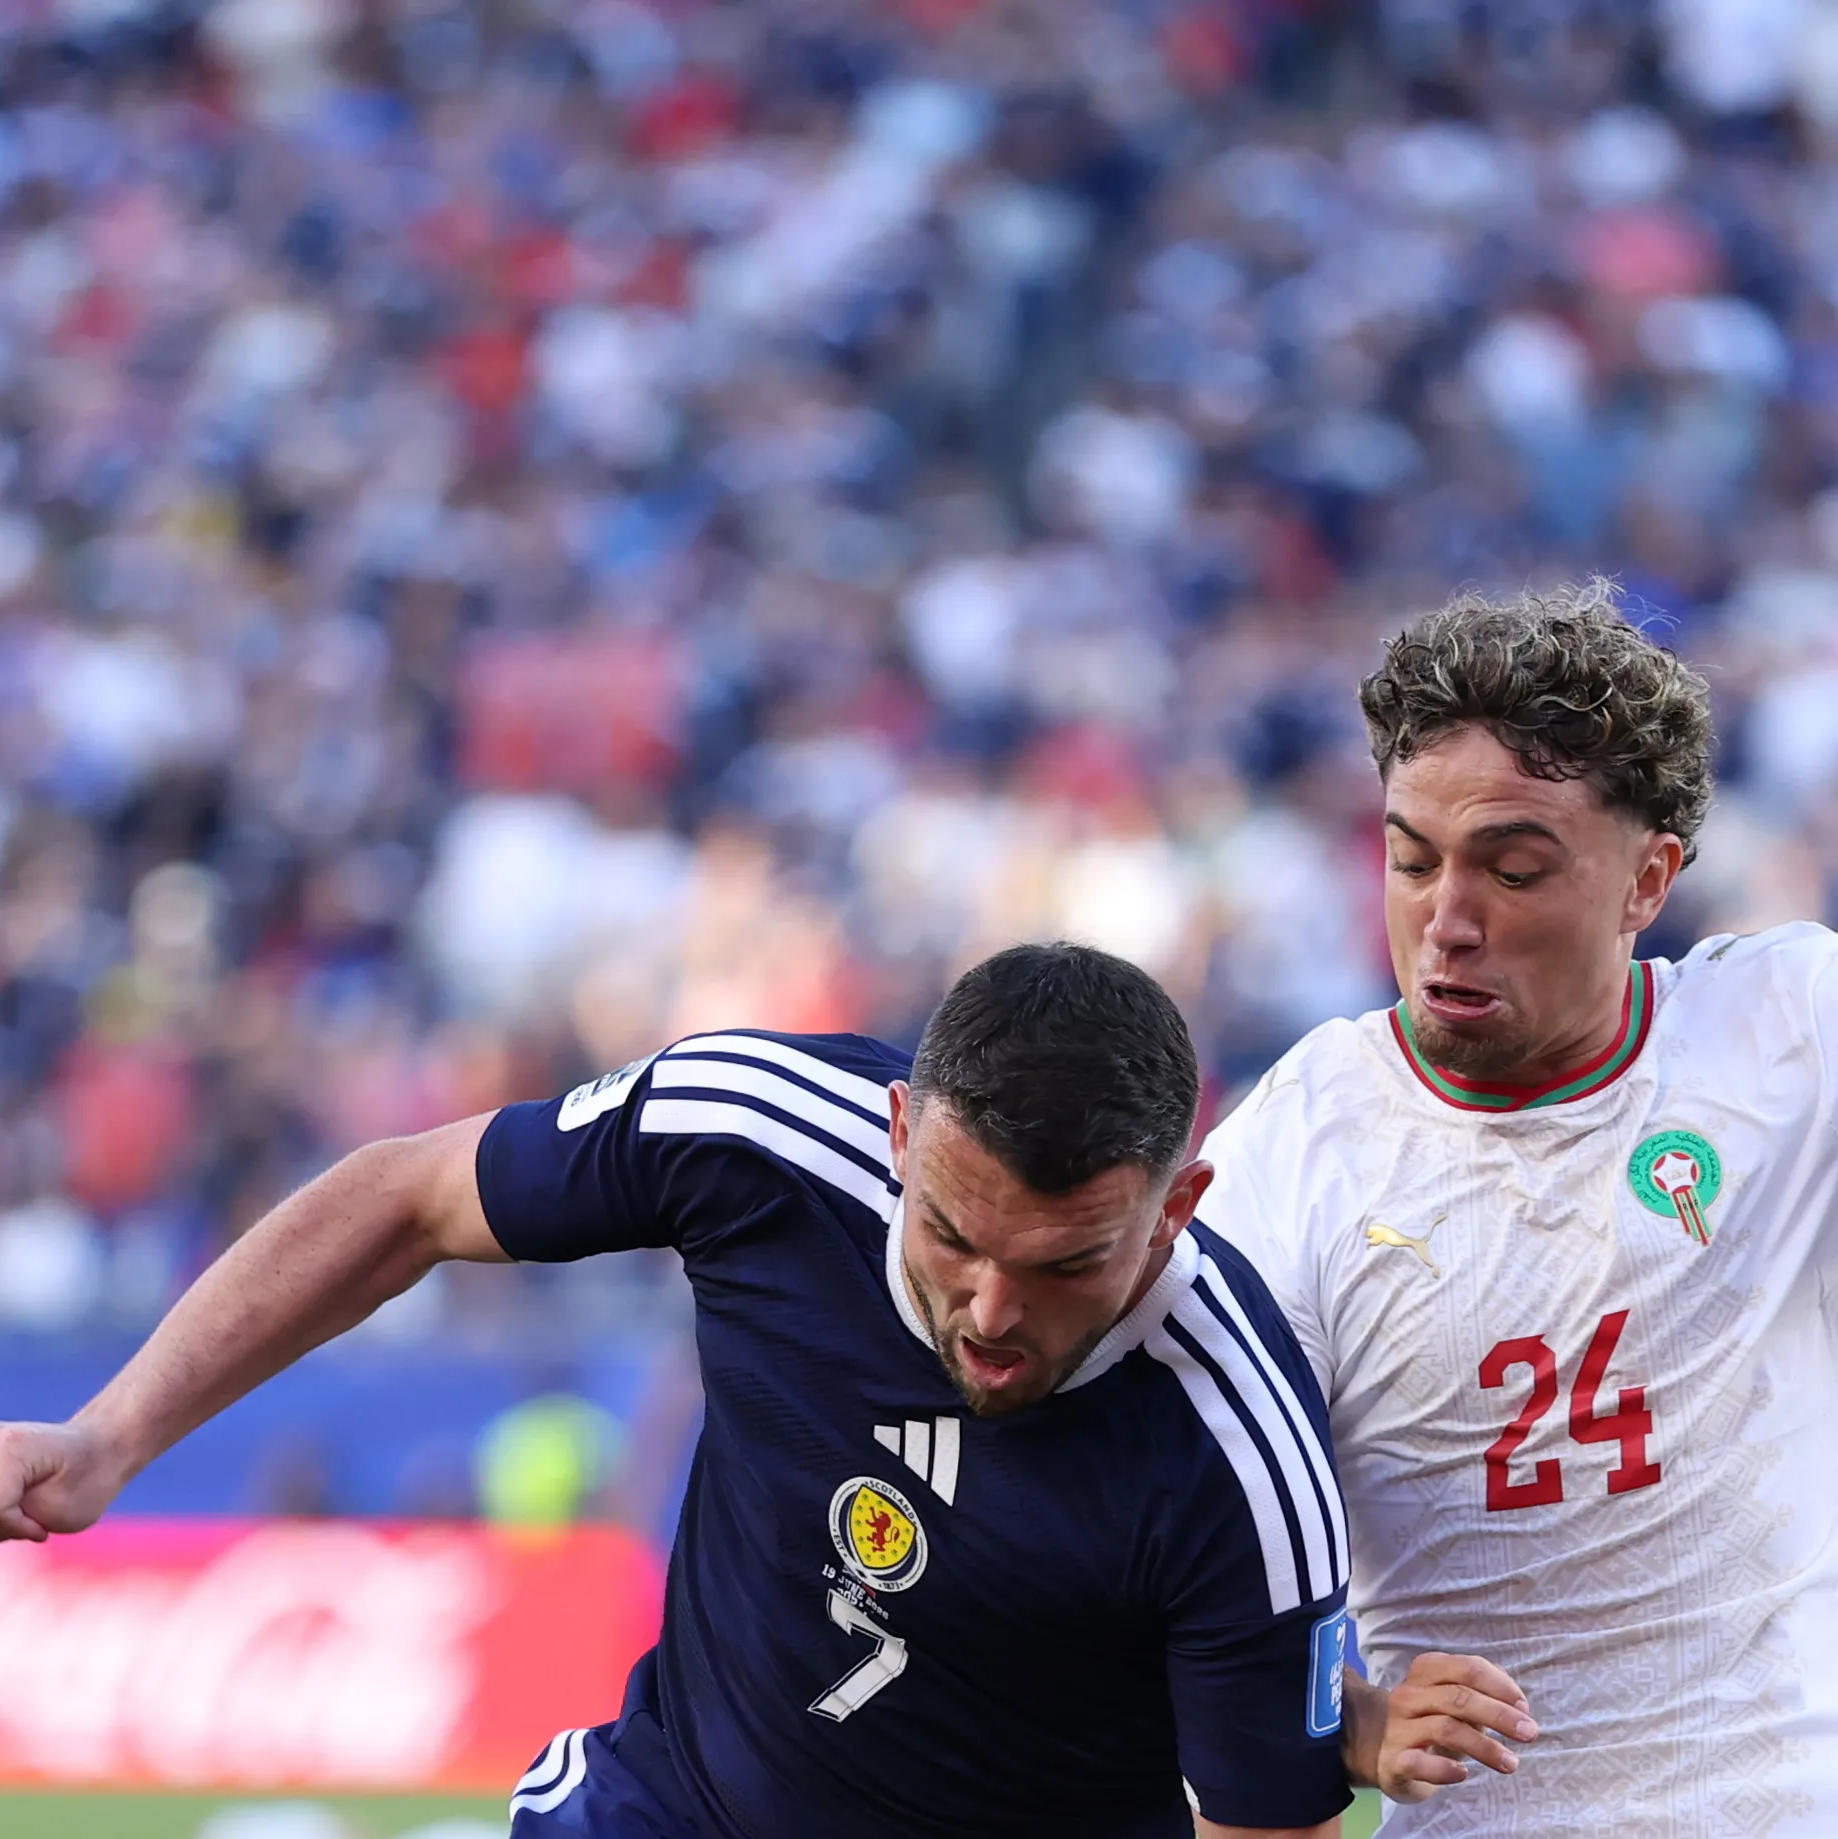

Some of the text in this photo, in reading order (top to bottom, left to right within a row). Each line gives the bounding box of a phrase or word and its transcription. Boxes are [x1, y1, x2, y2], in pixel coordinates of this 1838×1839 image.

[1478, 1309, 1662, 1512] 24
[869, 1480, 915, 1520] SCOTLAND
[821, 1563, 836, 1579] 19
[837, 1575, 866, 1600] JUNE
[807, 1588, 909, 1723] 7
